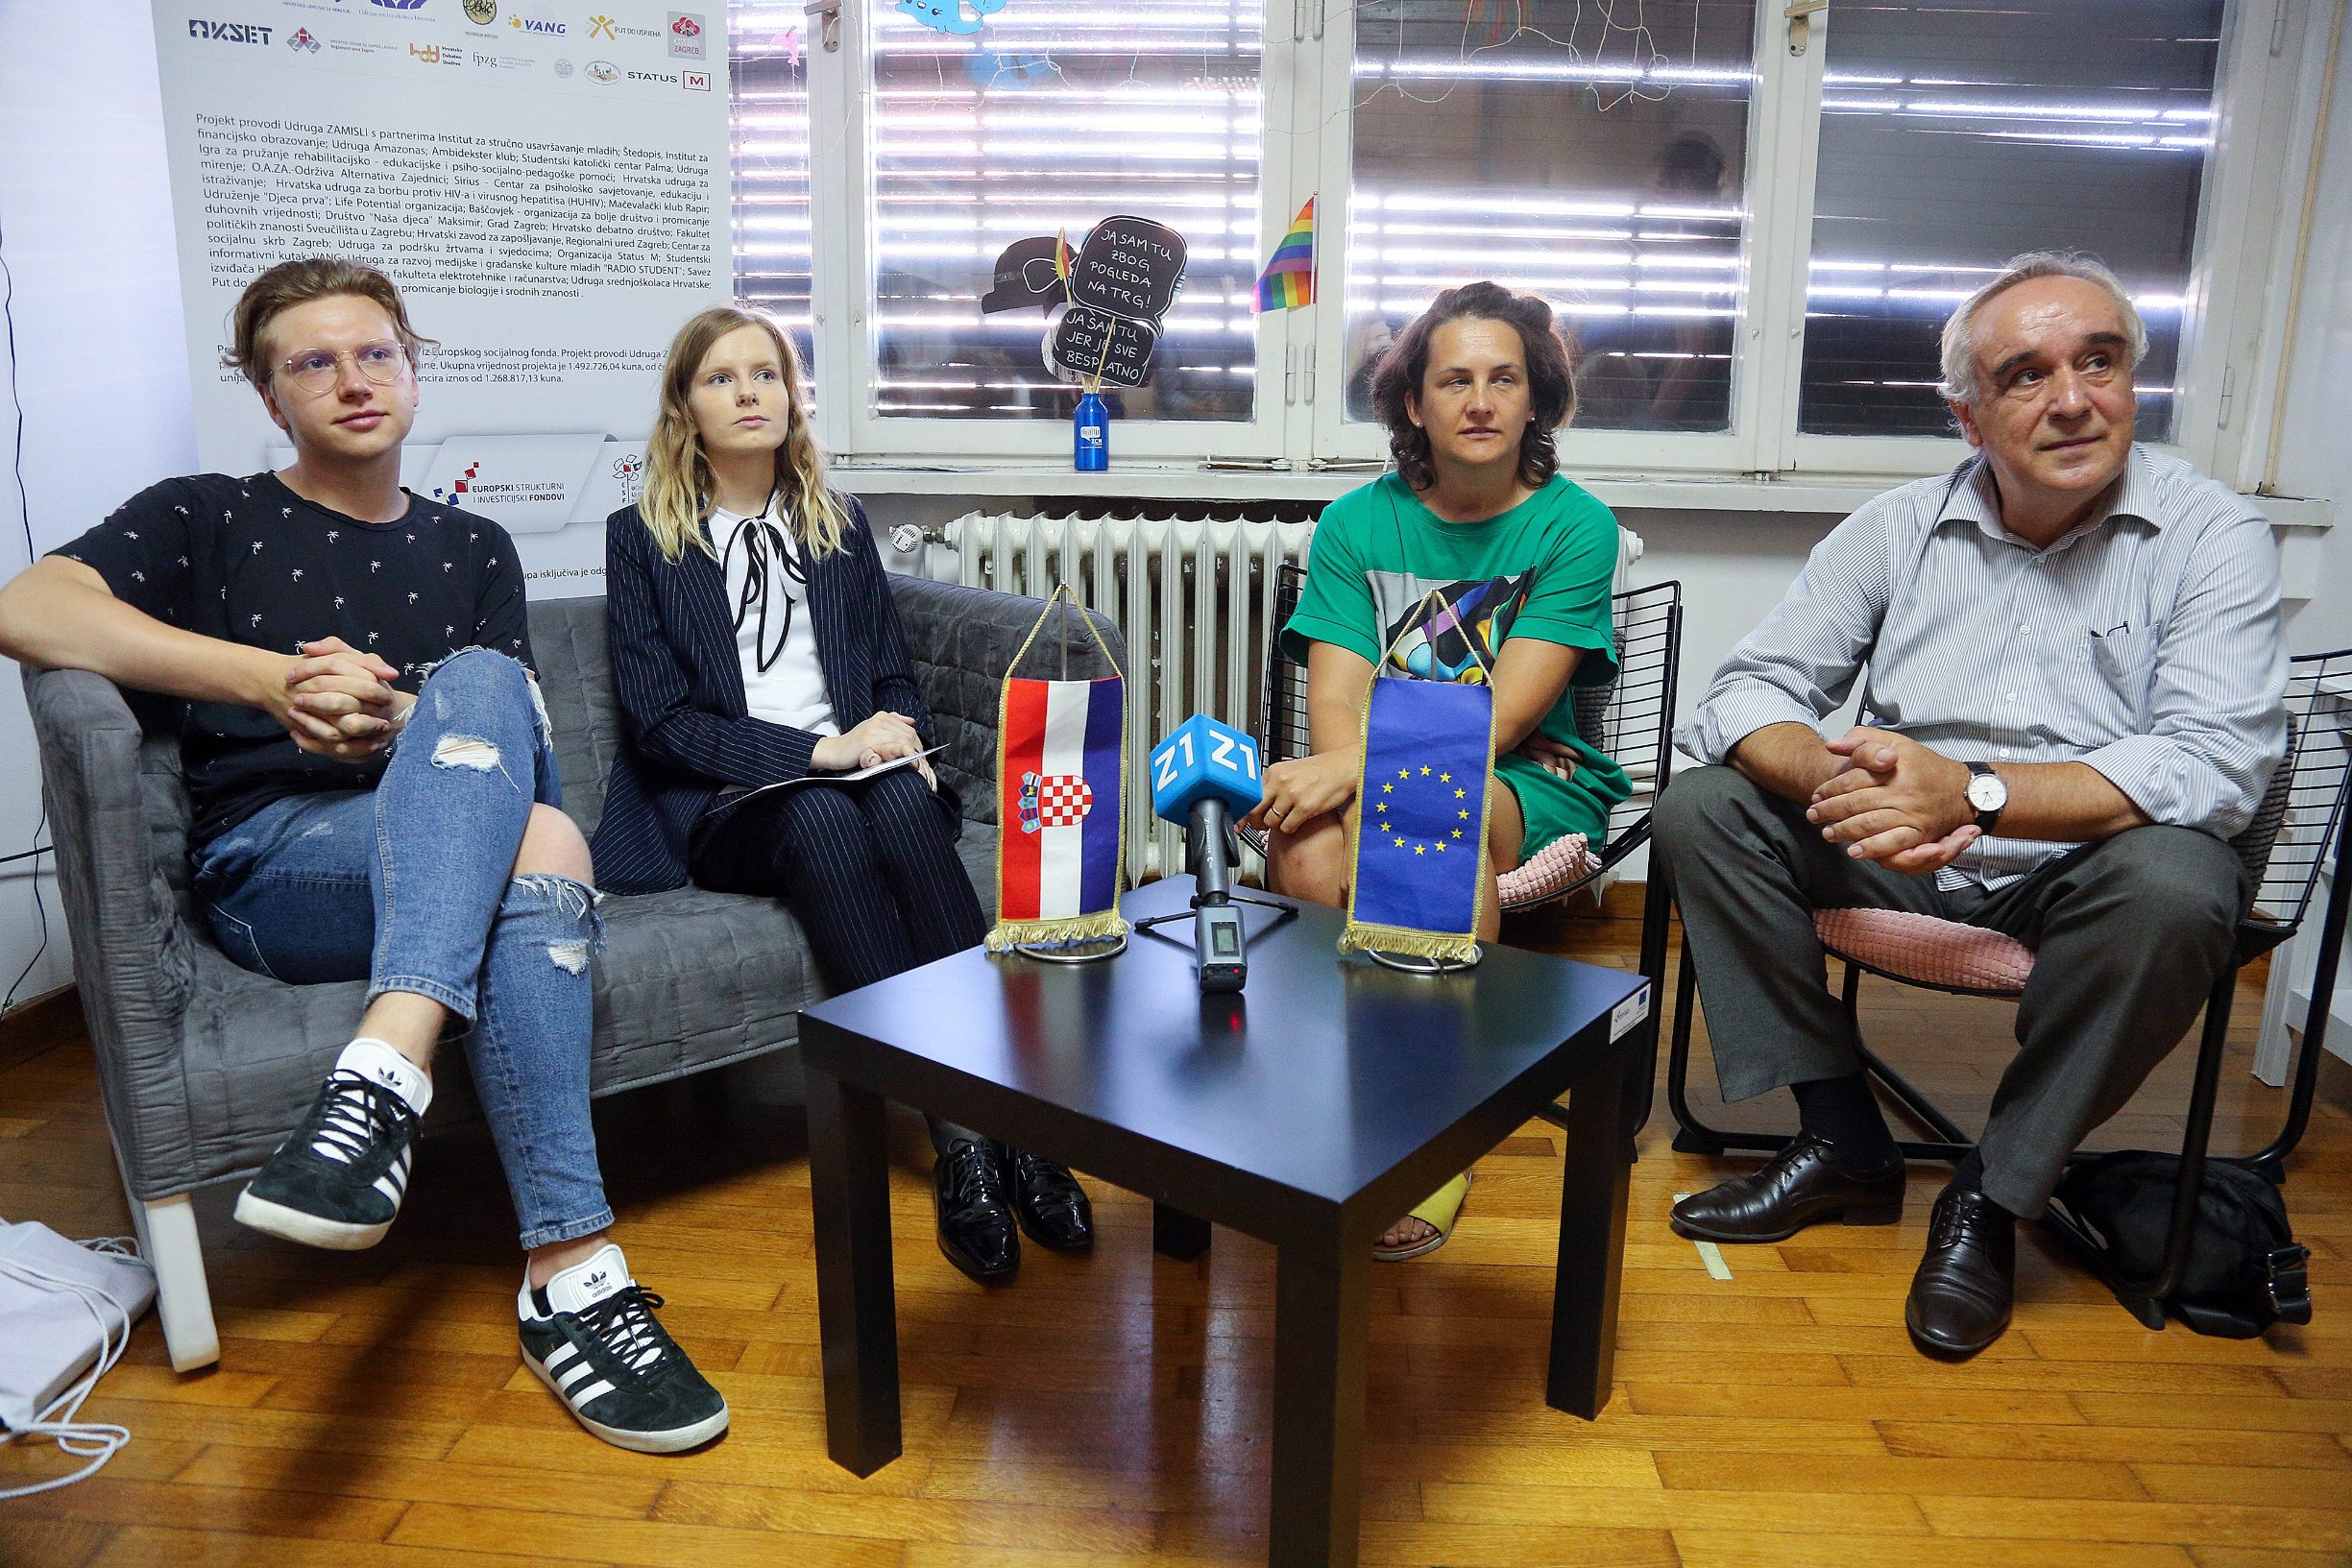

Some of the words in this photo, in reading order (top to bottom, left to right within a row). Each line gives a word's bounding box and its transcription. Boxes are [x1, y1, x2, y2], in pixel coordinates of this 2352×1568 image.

[524, 19, 567, 35] VANG
[615, 26, 626, 35] PUT
[636, 28, 662, 38] USPJEHA
[673, 37, 699, 47] CZSS
[674, 46, 700, 55] ZAGREB
[473, 51, 497, 68] fpzg
[627, 71, 678, 84] STATUS
[690, 76, 704, 86] M
[195, 112, 235, 127] Projekt
[238, 118, 281, 130] provodi
[283, 120, 324, 135] Udruga
[326, 124, 368, 137] ZAMISLI
[378, 130, 435, 142] partnerima
[438, 132, 473, 145] Institut
[474, 137, 486, 146] za
[488, 137, 523, 149] stručno
[525, 141, 585, 156] usavršavanje
[586, 145, 620, 157] mladih;
[622, 145, 664, 160] Štedopis,
[665, 150, 696, 162] Institut
[197, 127, 256, 143] financijsko
[260, 133, 328, 150] obrazovanje;
[331, 138, 370, 154] Udruga
[373, 142, 428, 157] Amazonas;
[431, 146, 493, 160] Ambidekster
[495, 150, 519, 163] klub;
[521, 153, 570, 166] Studentski
[572, 157, 611, 169] katolički
[613, 161, 644, 171] centar
[644, 161, 674, 174] Palma;
[676, 163, 709, 178] Udruga
[201, 173, 266, 189] istraživanje;
[276, 178, 322, 191] Hrvatska
[324, 181, 362, 196] udruga
[363, 185, 376, 194] za
[377, 183, 411, 196] borbu
[412, 187, 442, 199] protiv
[444, 187, 470, 200] HIV-a
[477, 190, 519, 205] virusnog
[520, 193, 566, 205] hepatitisa
[567, 196, 607, 209] (HUHIV);
[608, 198, 662, 211] Mačevalački
[664, 201, 684, 212] klub
[685, 203, 710, 215] Rapir;
[204, 203, 258, 216] duhovnih
[261, 206, 321, 221] vrijednosti;
[325, 209, 366, 222] Društvo
[437, 215, 483, 229] Maksimir;
[486, 218, 510, 229] Grad
[513, 219, 548, 232] Zagreb;
[551, 222, 593, 233] Hrvatsko
[595, 224, 634, 235] debatno
[637, 226, 673, 238] društvo;
[676, 228, 711, 239] Fakultet
[206, 218, 257, 230] političkih
[258, 222, 304, 232] znanosti
[305, 223, 359, 235] Sveučilišta
[370, 226, 415, 239] Zagrebu;
[416, 229, 457, 240] Hrvatski
[457, 230, 487, 241] zavod
[488, 233, 499, 242] za
[499, 233, 565, 247] zapošljavanje,
[564, 235, 613, 248] Regionalni
[614, 238, 635, 248] ured
[636, 238, 670, 252] Zagreb;
[670, 240, 700, 251] Centar
[700, 243, 711, 252] za
[207, 232, 256, 246] socijalnu
[262, 234, 286, 246] skrb
[291, 236, 331, 250] Zagreb;
[337, 238, 376, 253] Udruga
[380, 242, 393, 251] za
[399, 241, 440, 253] podršku
[445, 243, 484, 254] žrtvama
[497, 246, 552, 258] svjedocima;
[556, 248, 613, 262] Organizacija
[617, 251, 645, 261] Status
[649, 252, 662, 263] M;
[666, 253, 711, 264] Studentski
[1101, 229, 1117, 246] JA
[1119, 233, 1148, 252] SAM
[1151, 243, 1173, 261] TU
[209, 262, 255, 274] izviđača
[1111, 250, 1150, 272] ZBOG
[211, 277, 231, 288] Put
[232, 277, 249, 289] do
[392, 268, 437, 279] fakulteta
[438, 270, 507, 282] elektrotehnike
[514, 273, 569, 285] računarstva;
[570, 275, 604, 288] Udruga
[606, 277, 670, 289] srednjoškolaca
[672, 278, 712, 290] Hrvatske;
[1089, 261, 1152, 288] POGLEDA
[403, 285, 456, 296] promicanje
[457, 283, 499, 298] biologije
[504, 286, 540, 297] srodnih
[541, 288, 580, 298] znanosti
[1087, 280, 1107, 295] NA
[1110, 287, 1152, 309] TRG!
[1066, 312, 1084, 326] JA
[1118, 326, 1138, 343] TU
[482, 347, 529, 359] socijalnog
[530, 347, 560, 358] fonda.
[560, 348, 593, 360] Projekt
[593, 349, 628, 360] provodi
[628, 349, 663, 361] Udruga
[1066, 331, 1091, 348] JER
[1114, 343, 1138, 358] SVE
[439, 360, 475, 372] Ukupna
[475, 360, 521, 373] vrijednost
[521, 360, 557, 373] projekta
[557, 361, 567, 373] je
[568, 361, 620, 372] 1.492.726,04
[620, 361, 644, 372] kuna,
[644, 362, 657, 372] od
[1066, 350, 1139, 380] BESPATNO
[445, 373, 470, 383] iznos
[470, 373, 483, 383] od
[484, 373, 539, 384] 1.268.817,13
[540, 373, 564, 383] kuna.
[472, 484, 514, 493] EUROPSKI
[515, 482, 565, 492] STRUKTURNI
[477, 495, 528, 503] INVESTICIJSKI
[529, 493, 565, 501] FONDOVI
[540, 568, 579, 580] isključiva
[580, 568, 589, 577] je
[1154, 732, 1195, 792] Z1
[1208, 729, 1256, 781] Z1
[592, 1285, 613, 1298] adidas
